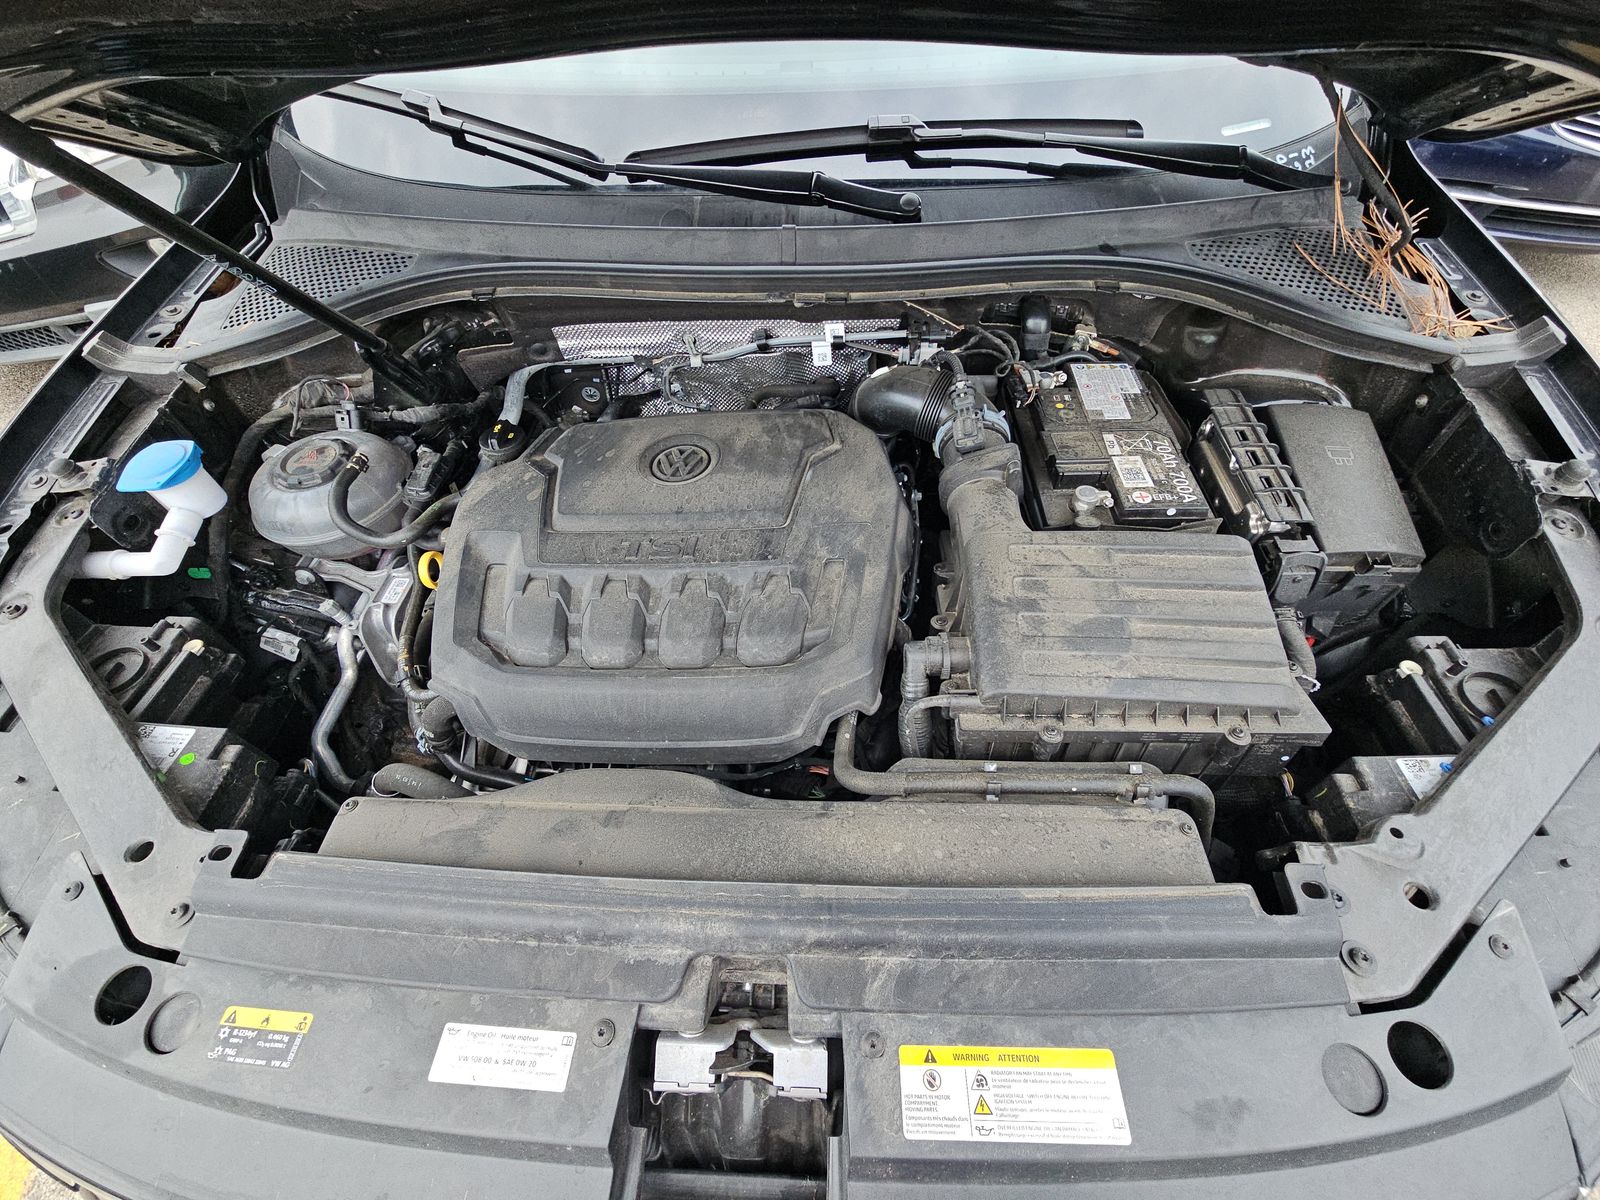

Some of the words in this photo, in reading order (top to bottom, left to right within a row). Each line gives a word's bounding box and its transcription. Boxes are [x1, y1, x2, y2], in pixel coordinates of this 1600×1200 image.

[1152, 439, 1179, 468] 70Ah
[1169, 471, 1198, 503] 700A
[952, 1053, 990, 1062] WARNING
[998, 1054, 1040, 1063] ATTENTION
